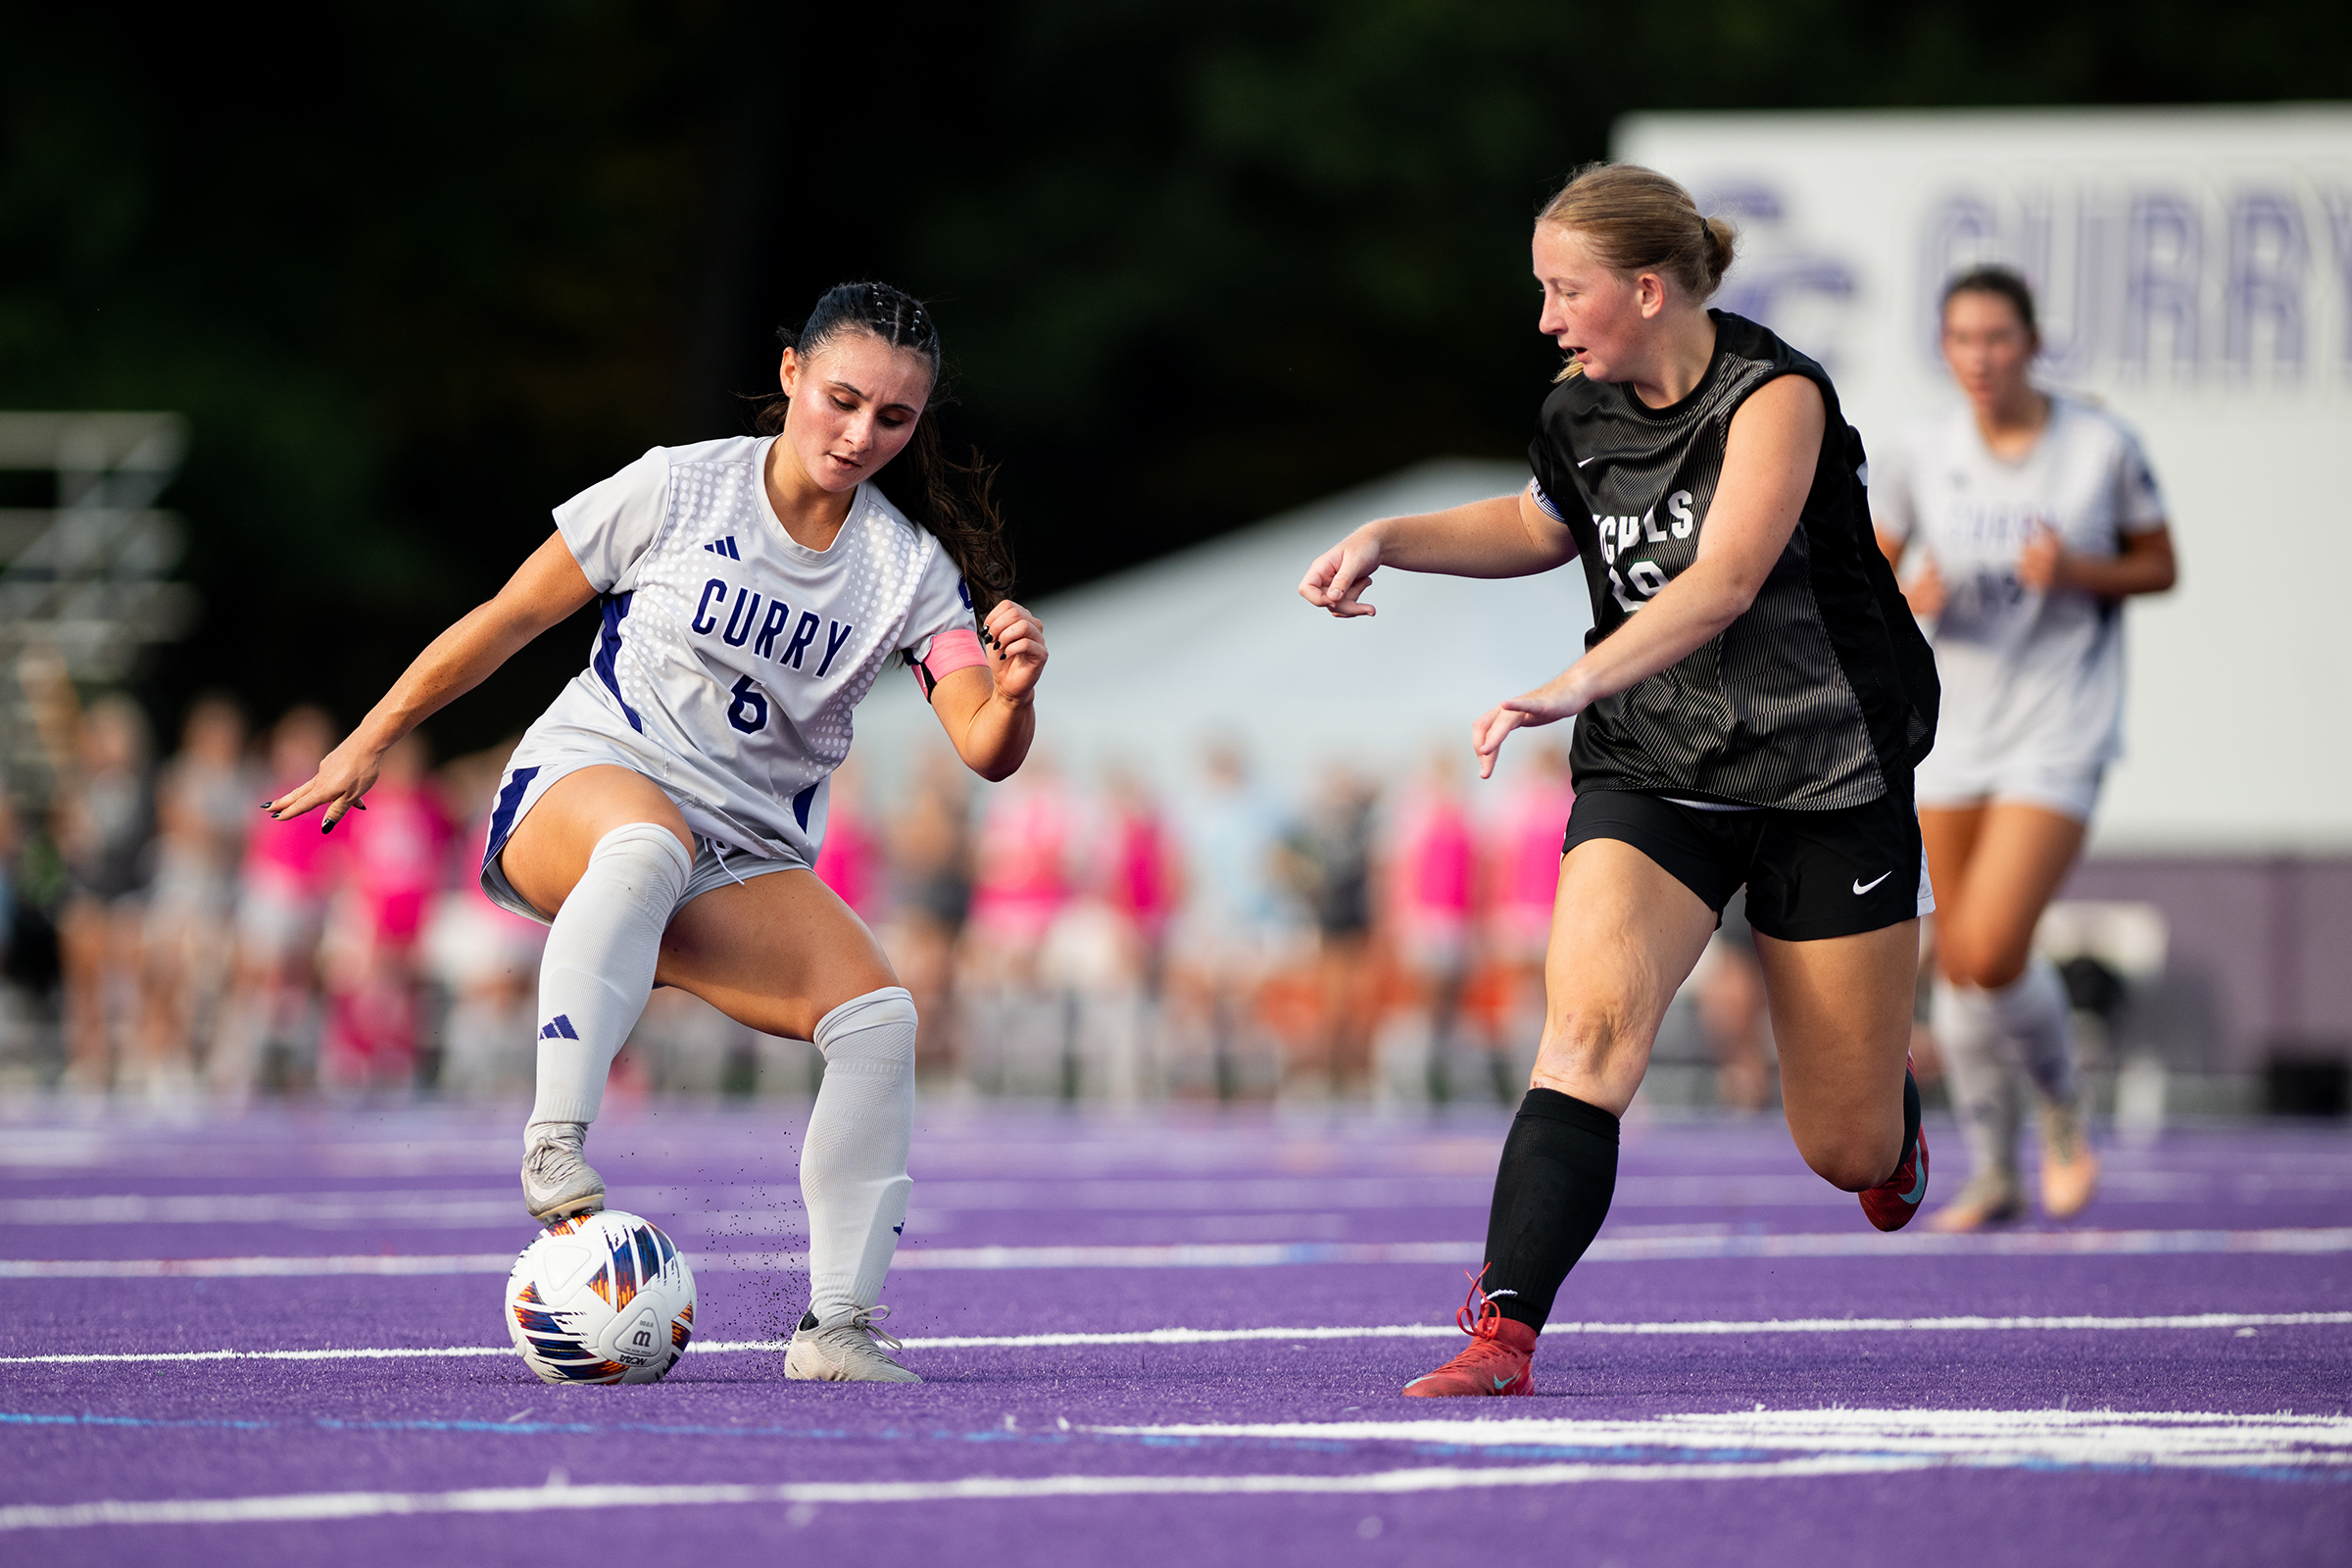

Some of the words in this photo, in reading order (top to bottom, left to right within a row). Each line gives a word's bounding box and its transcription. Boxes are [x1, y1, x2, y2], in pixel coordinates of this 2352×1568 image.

[691, 577, 853, 678] CURRY
[726, 673, 769, 735] 6
[618, 1354, 648, 1366] NCAA
